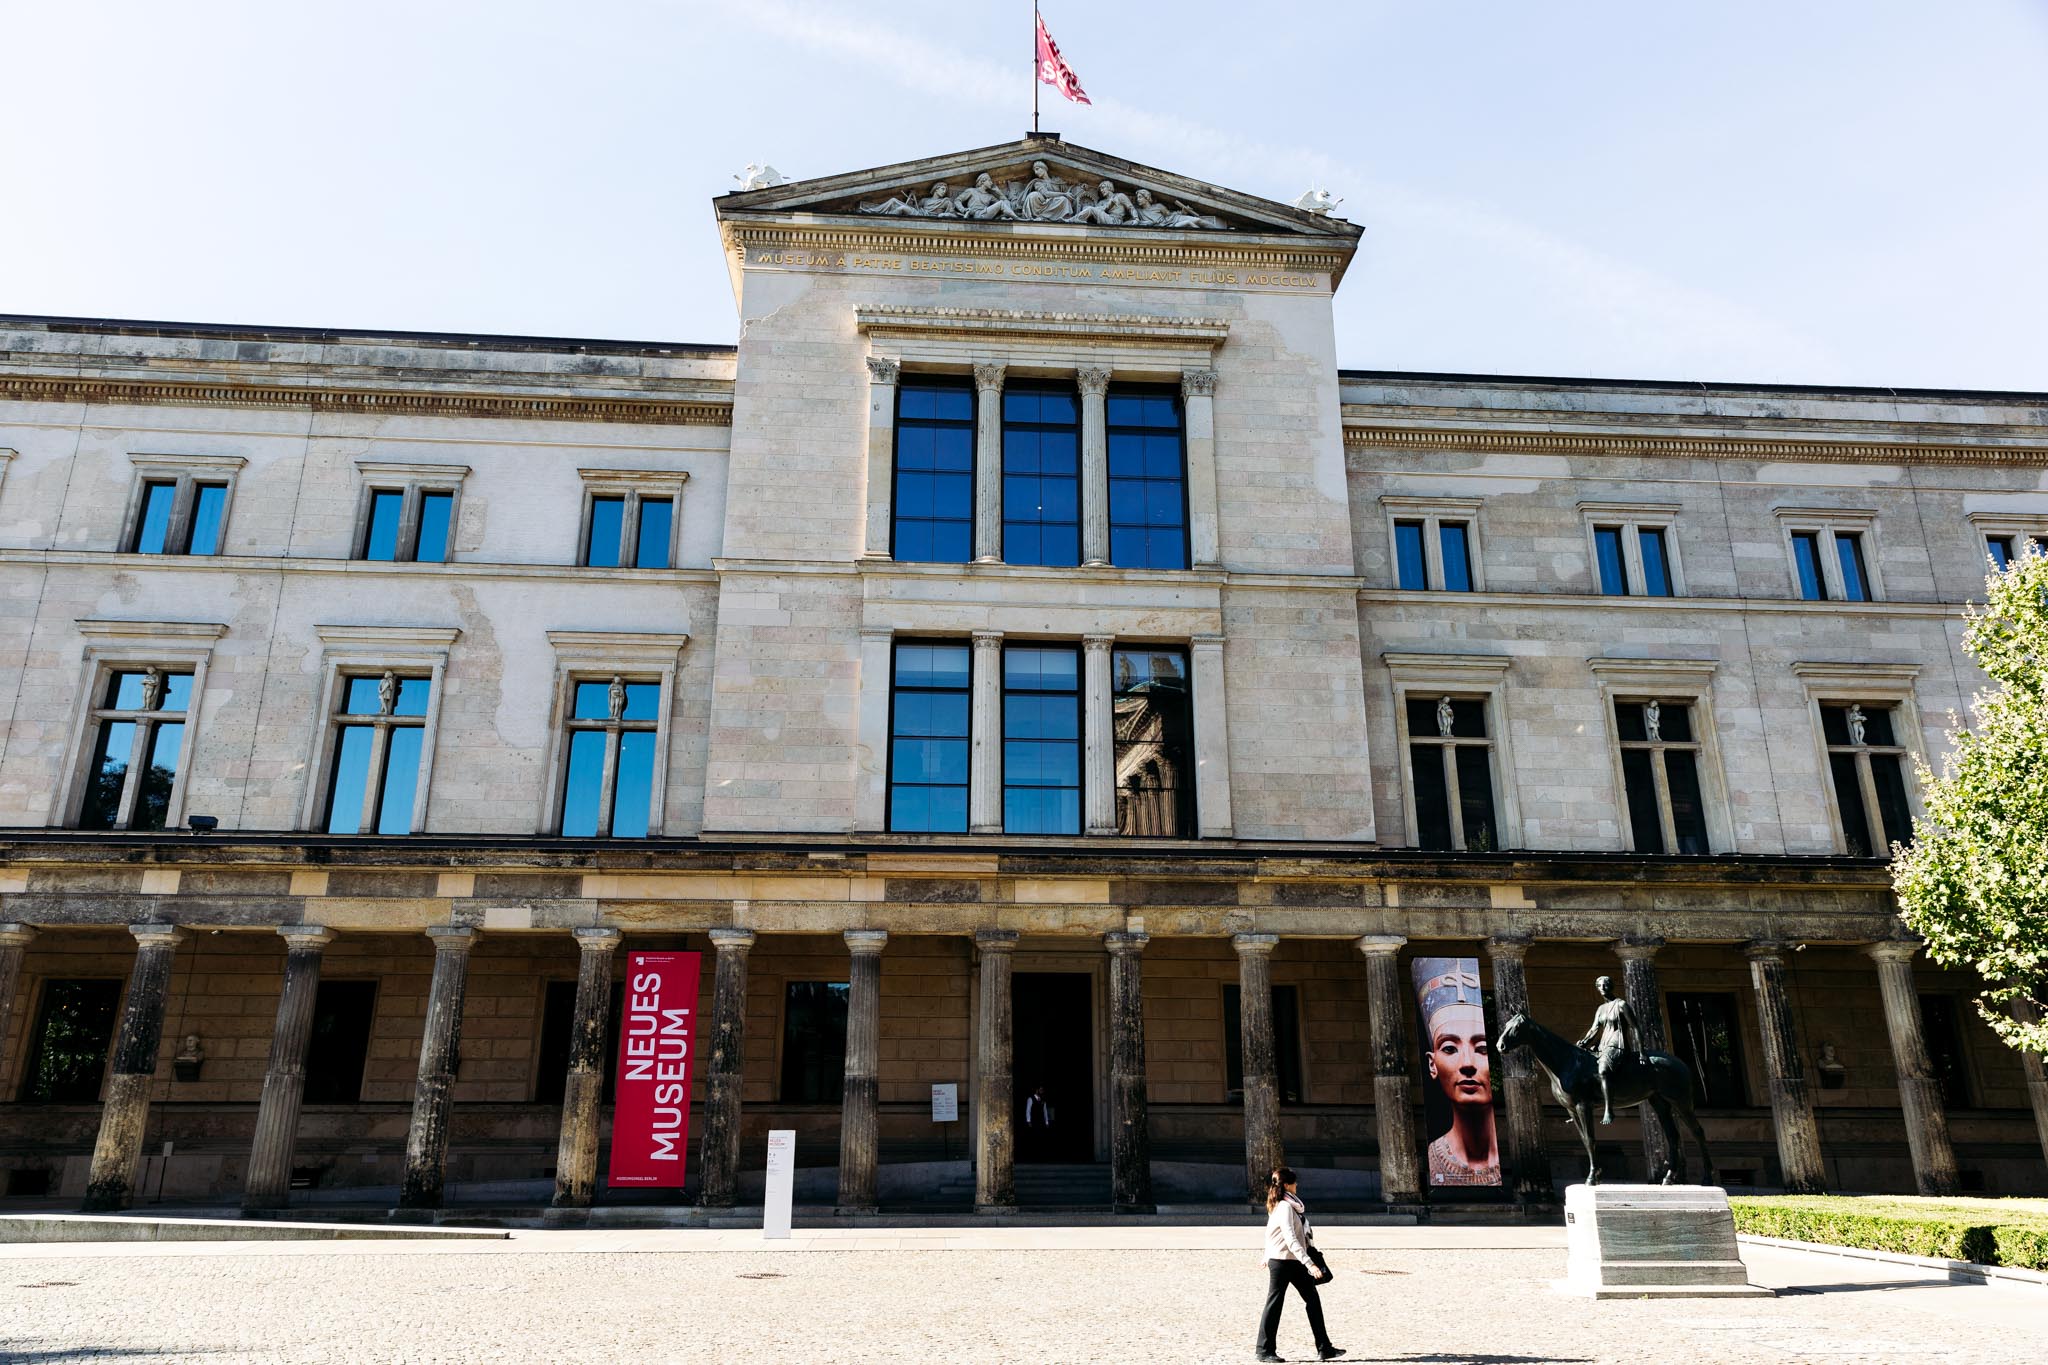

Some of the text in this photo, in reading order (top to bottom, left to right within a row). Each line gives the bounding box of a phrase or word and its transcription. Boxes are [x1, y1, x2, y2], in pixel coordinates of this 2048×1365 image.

[758, 253, 830, 266] MUSEUM
[836, 255, 846, 267] A
[853, 258, 902, 270] PATRE
[911, 260, 1004, 274] BEATISSIMO
[1012, 264, 1092, 278] CONDITUM
[1100, 269, 1182, 282] AMPLIAVIT
[1190, 272, 1239, 284] FILIUS.
[625, 973, 661, 1080] NEUES
[650, 1009, 689, 1160] MUSEUM
